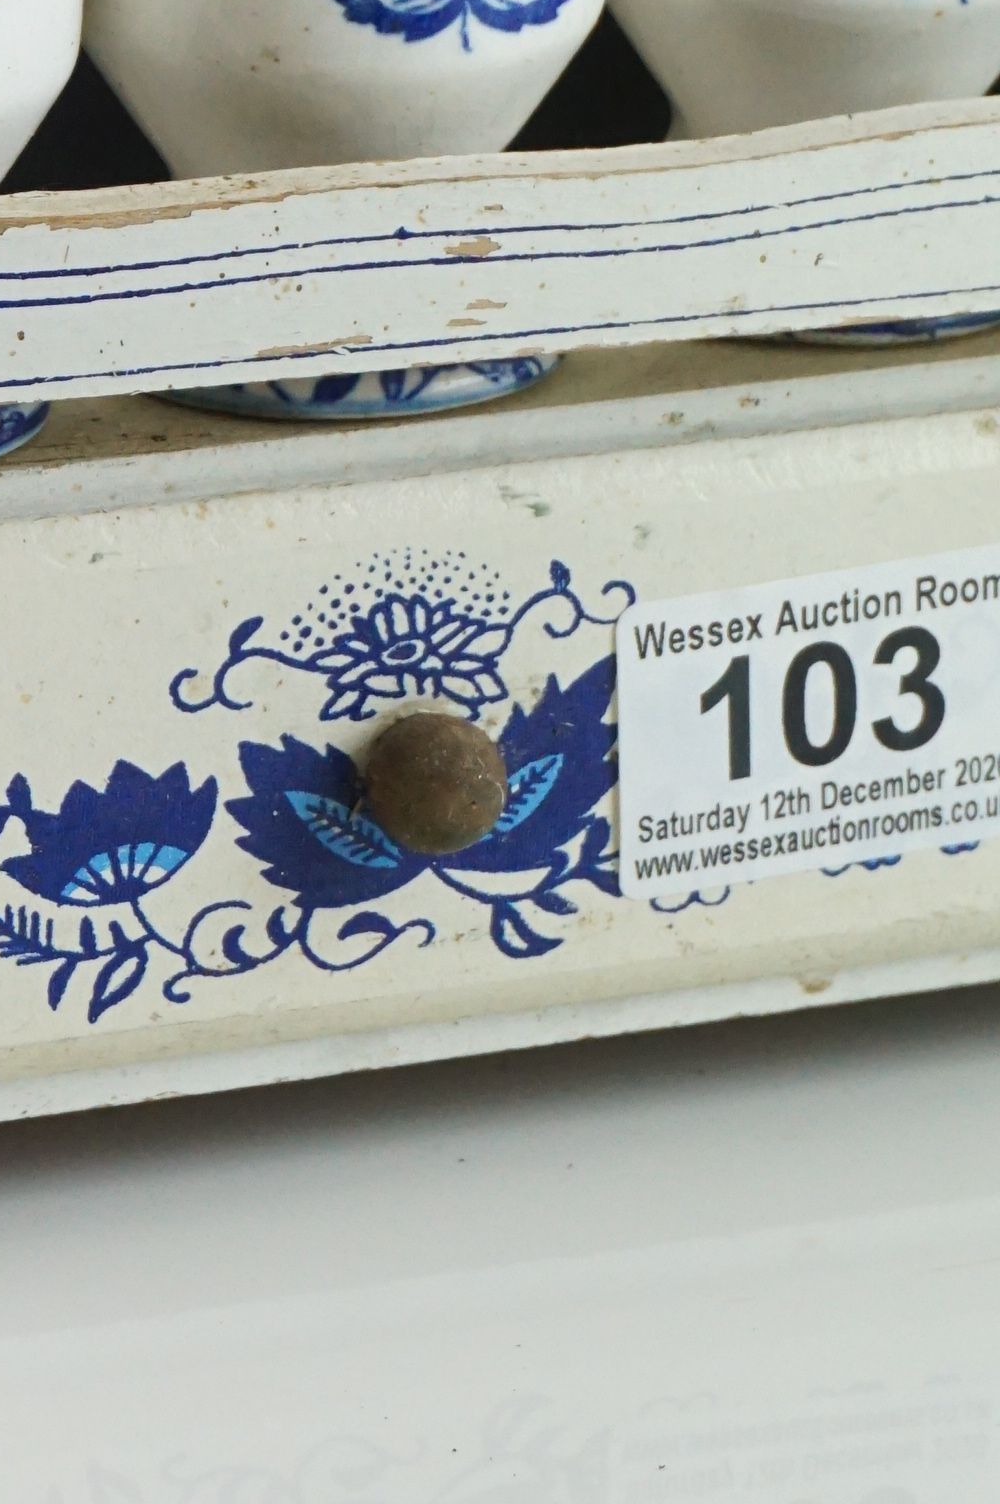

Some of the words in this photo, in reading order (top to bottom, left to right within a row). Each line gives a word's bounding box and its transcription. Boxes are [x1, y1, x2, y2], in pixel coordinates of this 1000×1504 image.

[633, 613, 763, 660] Wessex
[775, 588, 902, 635] Auction
[700, 625, 946, 781] 103
[638, 802, 751, 844] Saturday
[760, 789, 810, 822] 12th
[821, 767, 946, 811] December
